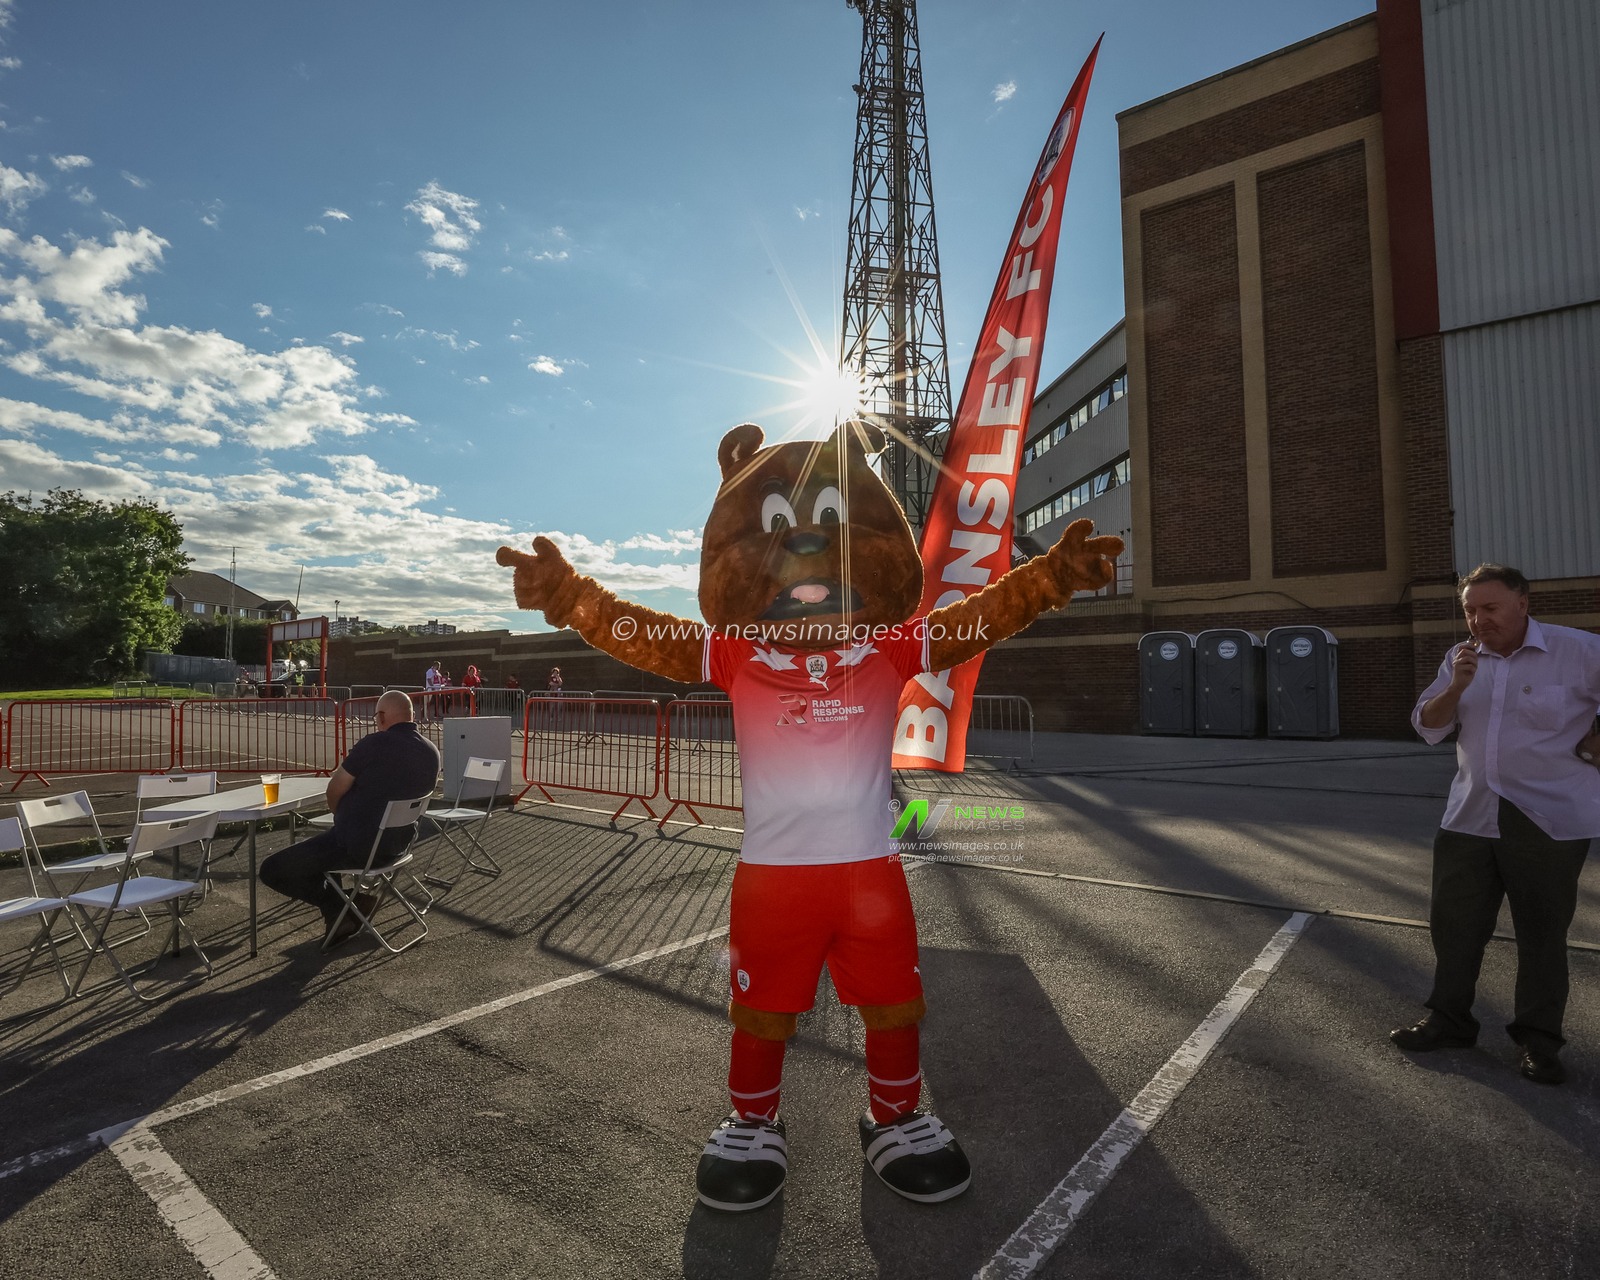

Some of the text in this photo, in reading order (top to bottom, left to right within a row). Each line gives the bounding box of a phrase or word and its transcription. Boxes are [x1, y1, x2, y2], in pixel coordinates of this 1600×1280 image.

[893, 184, 1053, 763] BANSLEY FC
[812, 699, 841, 708] RAPID
[812, 705, 865, 717] RESPONSE
